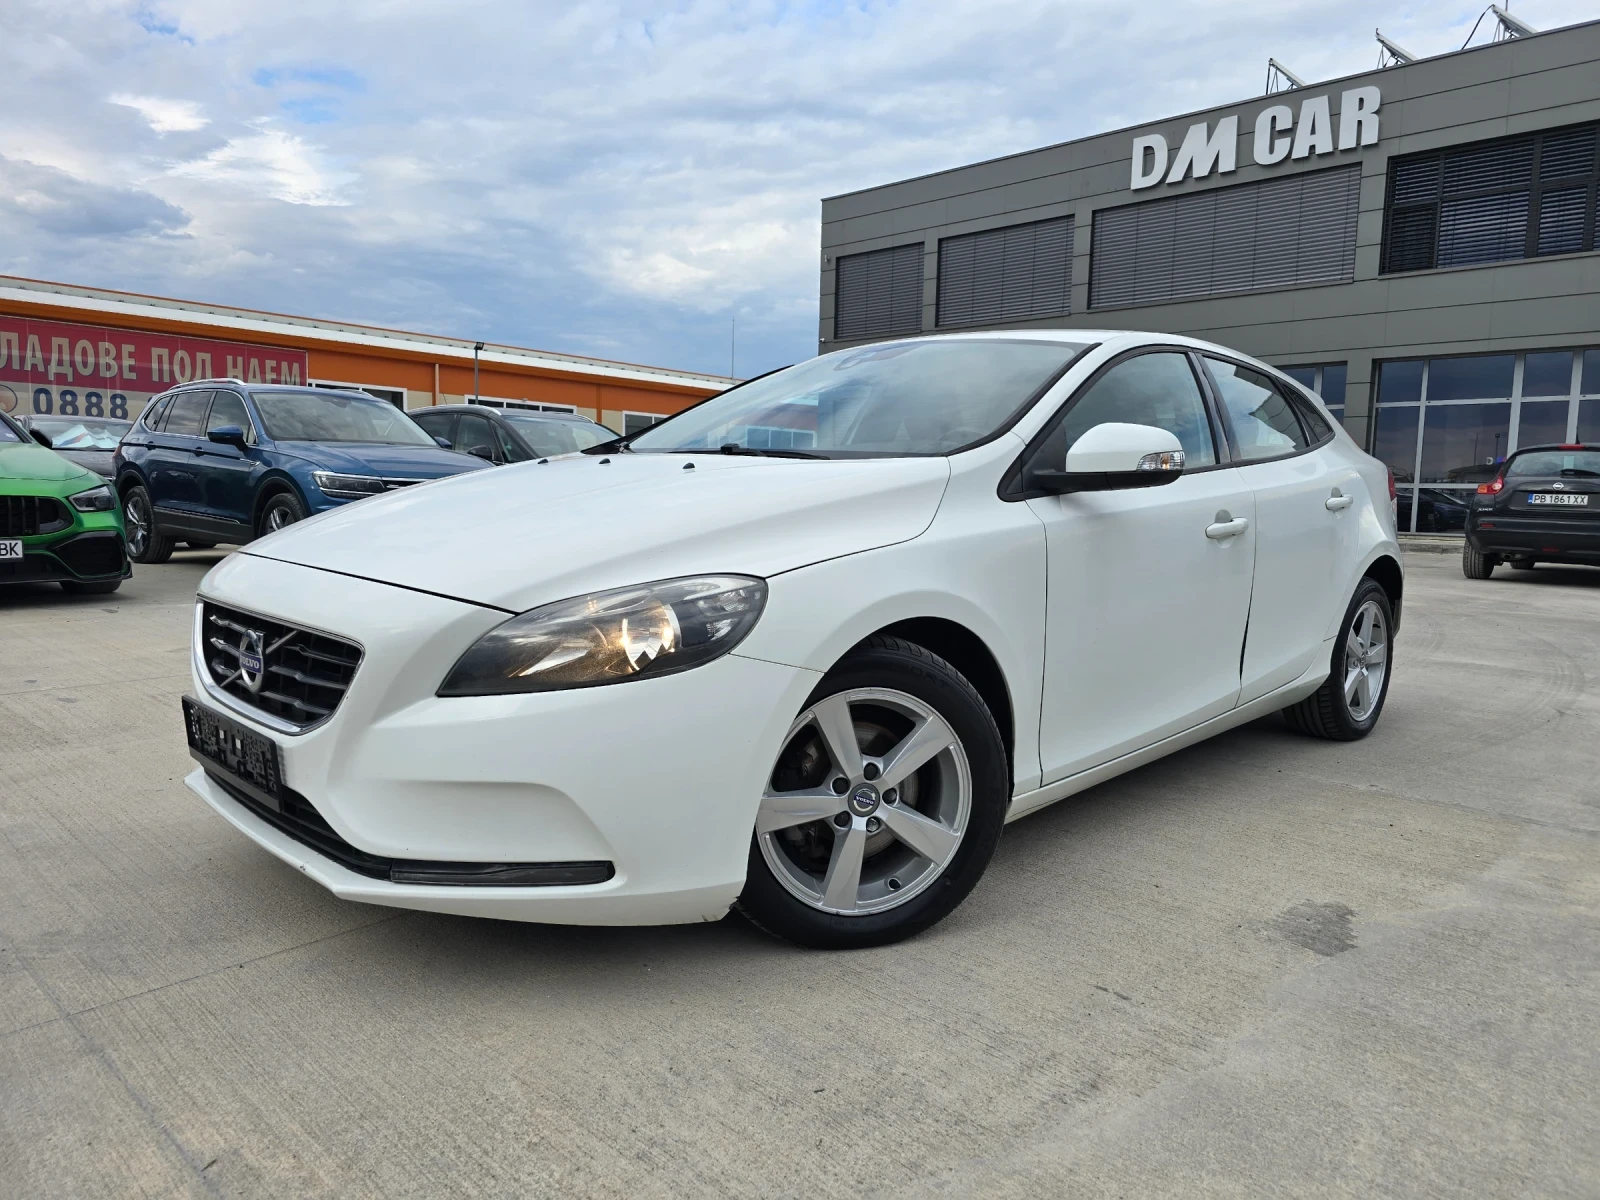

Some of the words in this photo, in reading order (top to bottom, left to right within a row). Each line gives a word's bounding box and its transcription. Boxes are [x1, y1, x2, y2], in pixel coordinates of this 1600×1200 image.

[1130, 115, 1238, 190] DM
[1253, 86, 1380, 165] CAR
[227, 355, 300, 386] НАЕМ
[33, 387, 128, 420] 0888
[1533, 495, 1546, 503] PB
[1549, 495, 1571, 503] 1861
[1573, 496, 1586, 504] XX
[0, 542, 19, 556] BK
[855, 795, 874, 805] VOLVO
